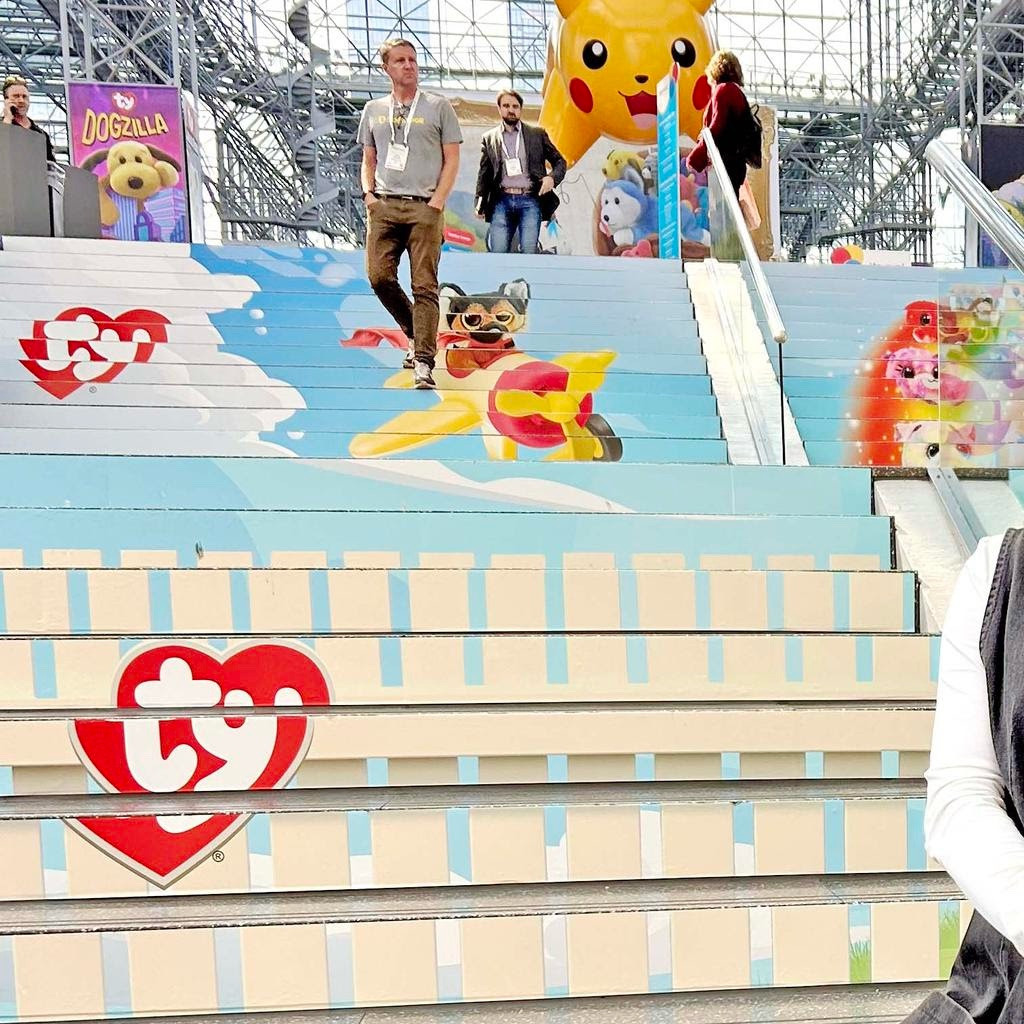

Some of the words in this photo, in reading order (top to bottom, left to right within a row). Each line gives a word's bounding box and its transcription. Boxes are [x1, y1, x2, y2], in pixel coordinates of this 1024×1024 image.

[81, 108, 169, 146] DOGZILLA
[113, 92, 136, 111] ty
[36, 313, 152, 382] ty
[123, 656, 304, 834] ty
